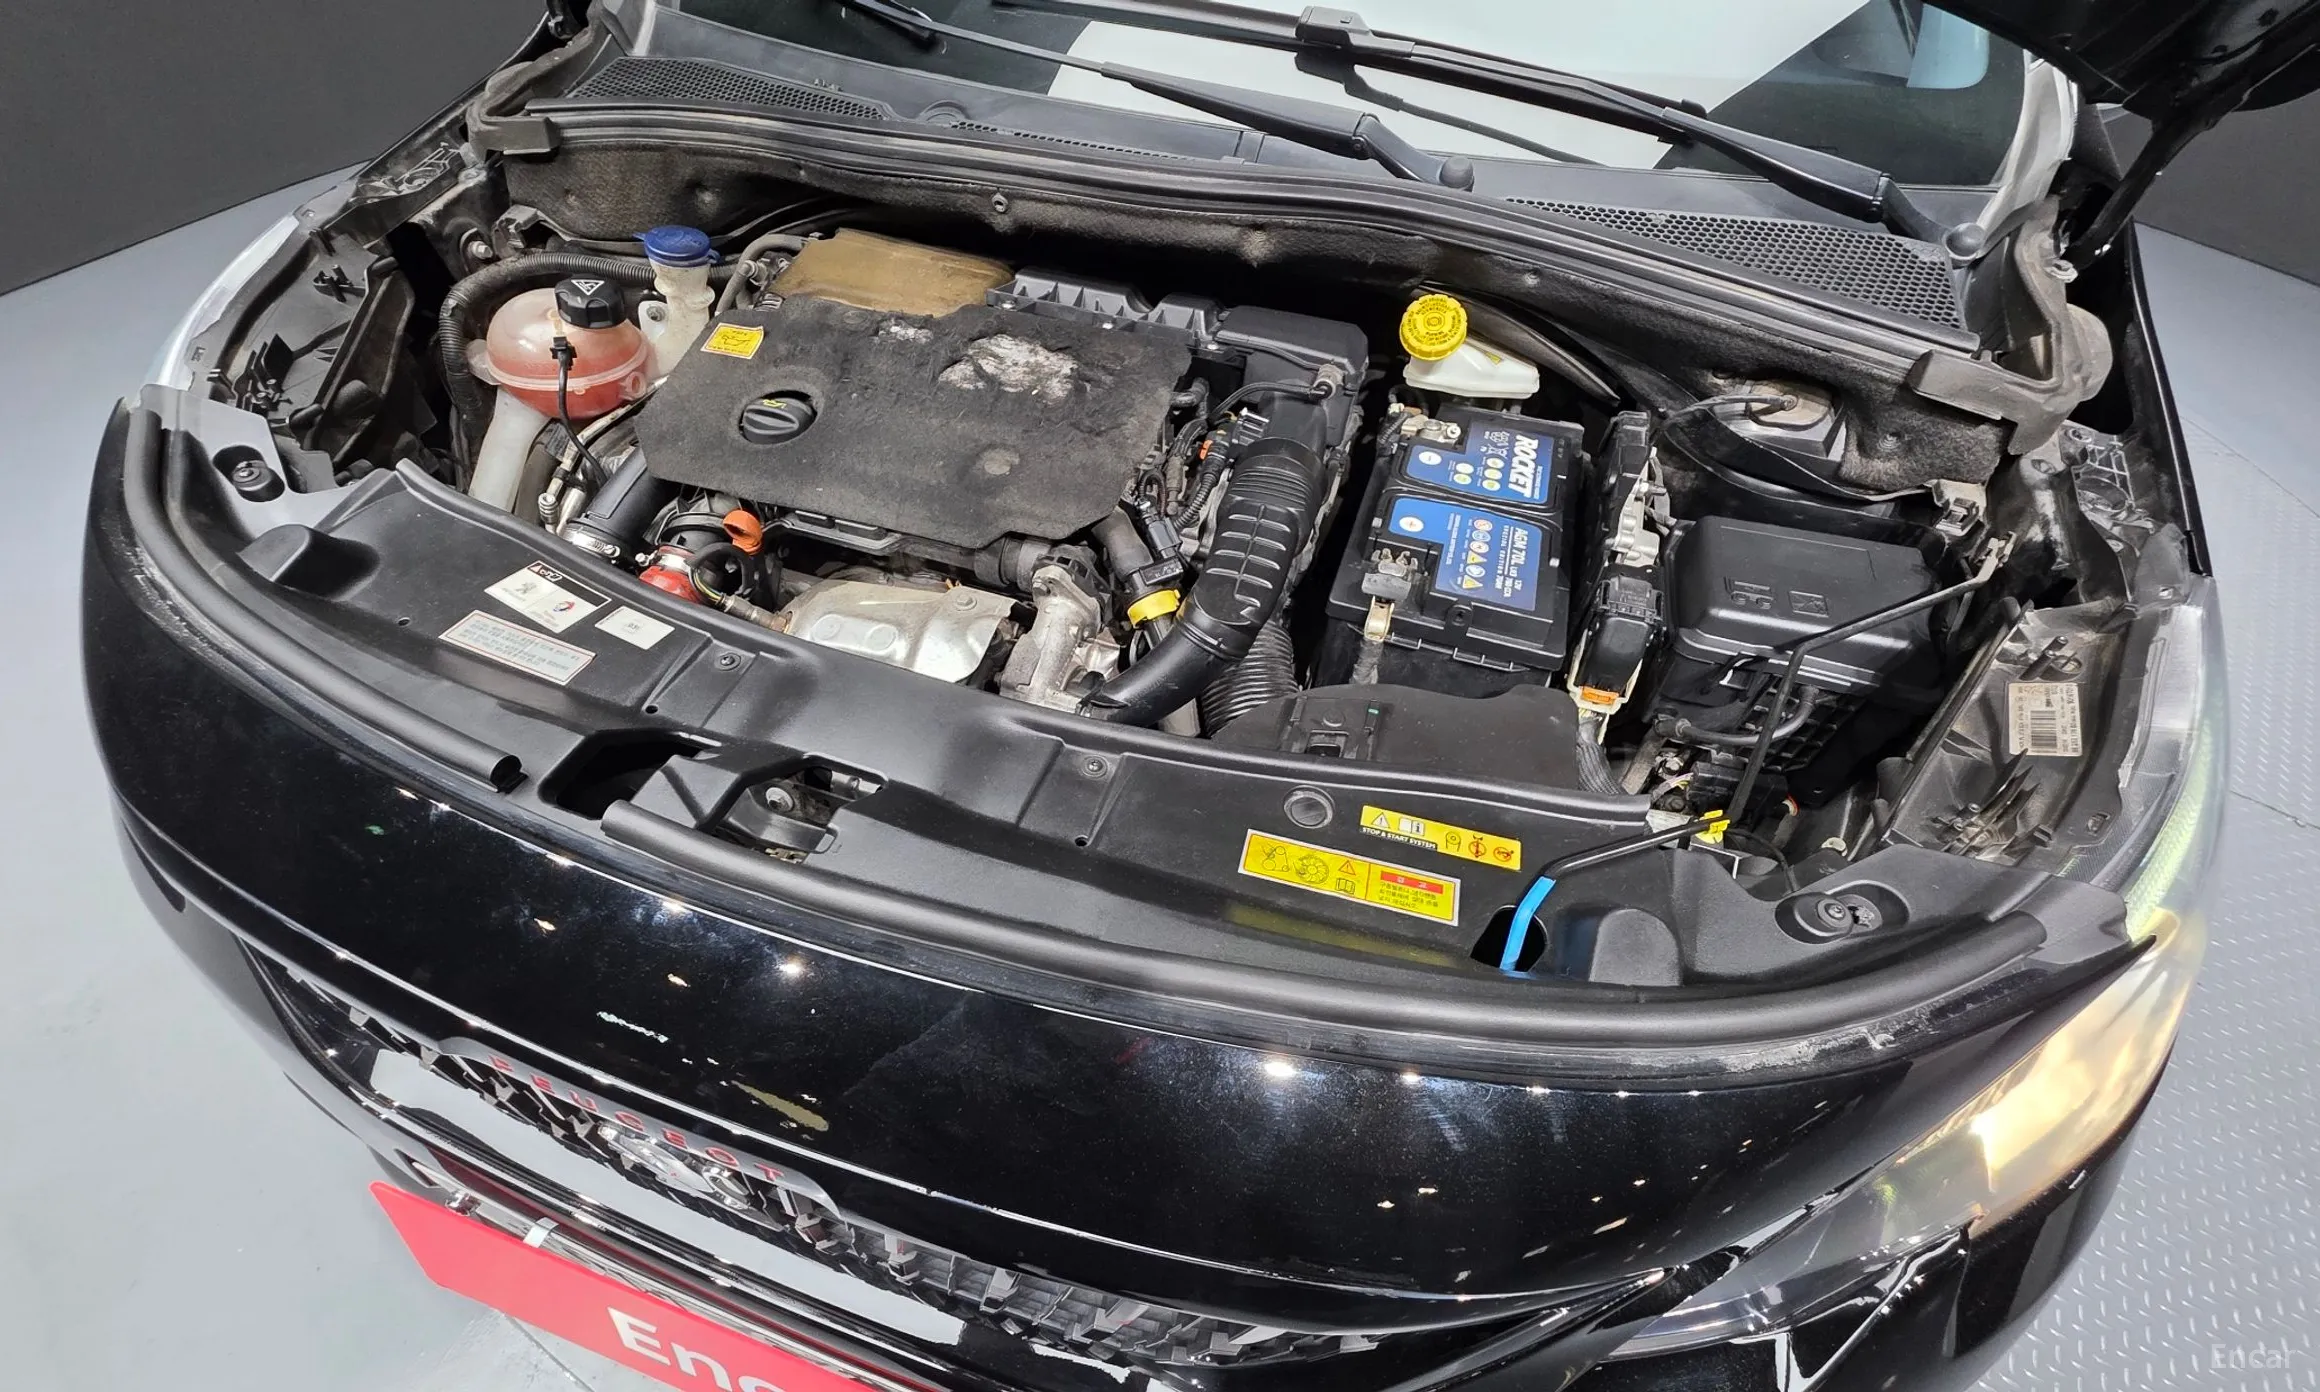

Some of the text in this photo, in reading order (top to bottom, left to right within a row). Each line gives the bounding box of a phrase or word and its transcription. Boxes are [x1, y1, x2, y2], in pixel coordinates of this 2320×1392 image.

[1508, 434, 1539, 498] ROCKET
[1500, 525, 1509, 547] SPECIAL
[1513, 527, 1529, 549] AGM
[1511, 549, 1526, 565] 70L
[1362, 827, 1381, 836] STOP
[1386, 832, 1409, 842] START
[1409, 837, 1436, 849] SYSTEM
